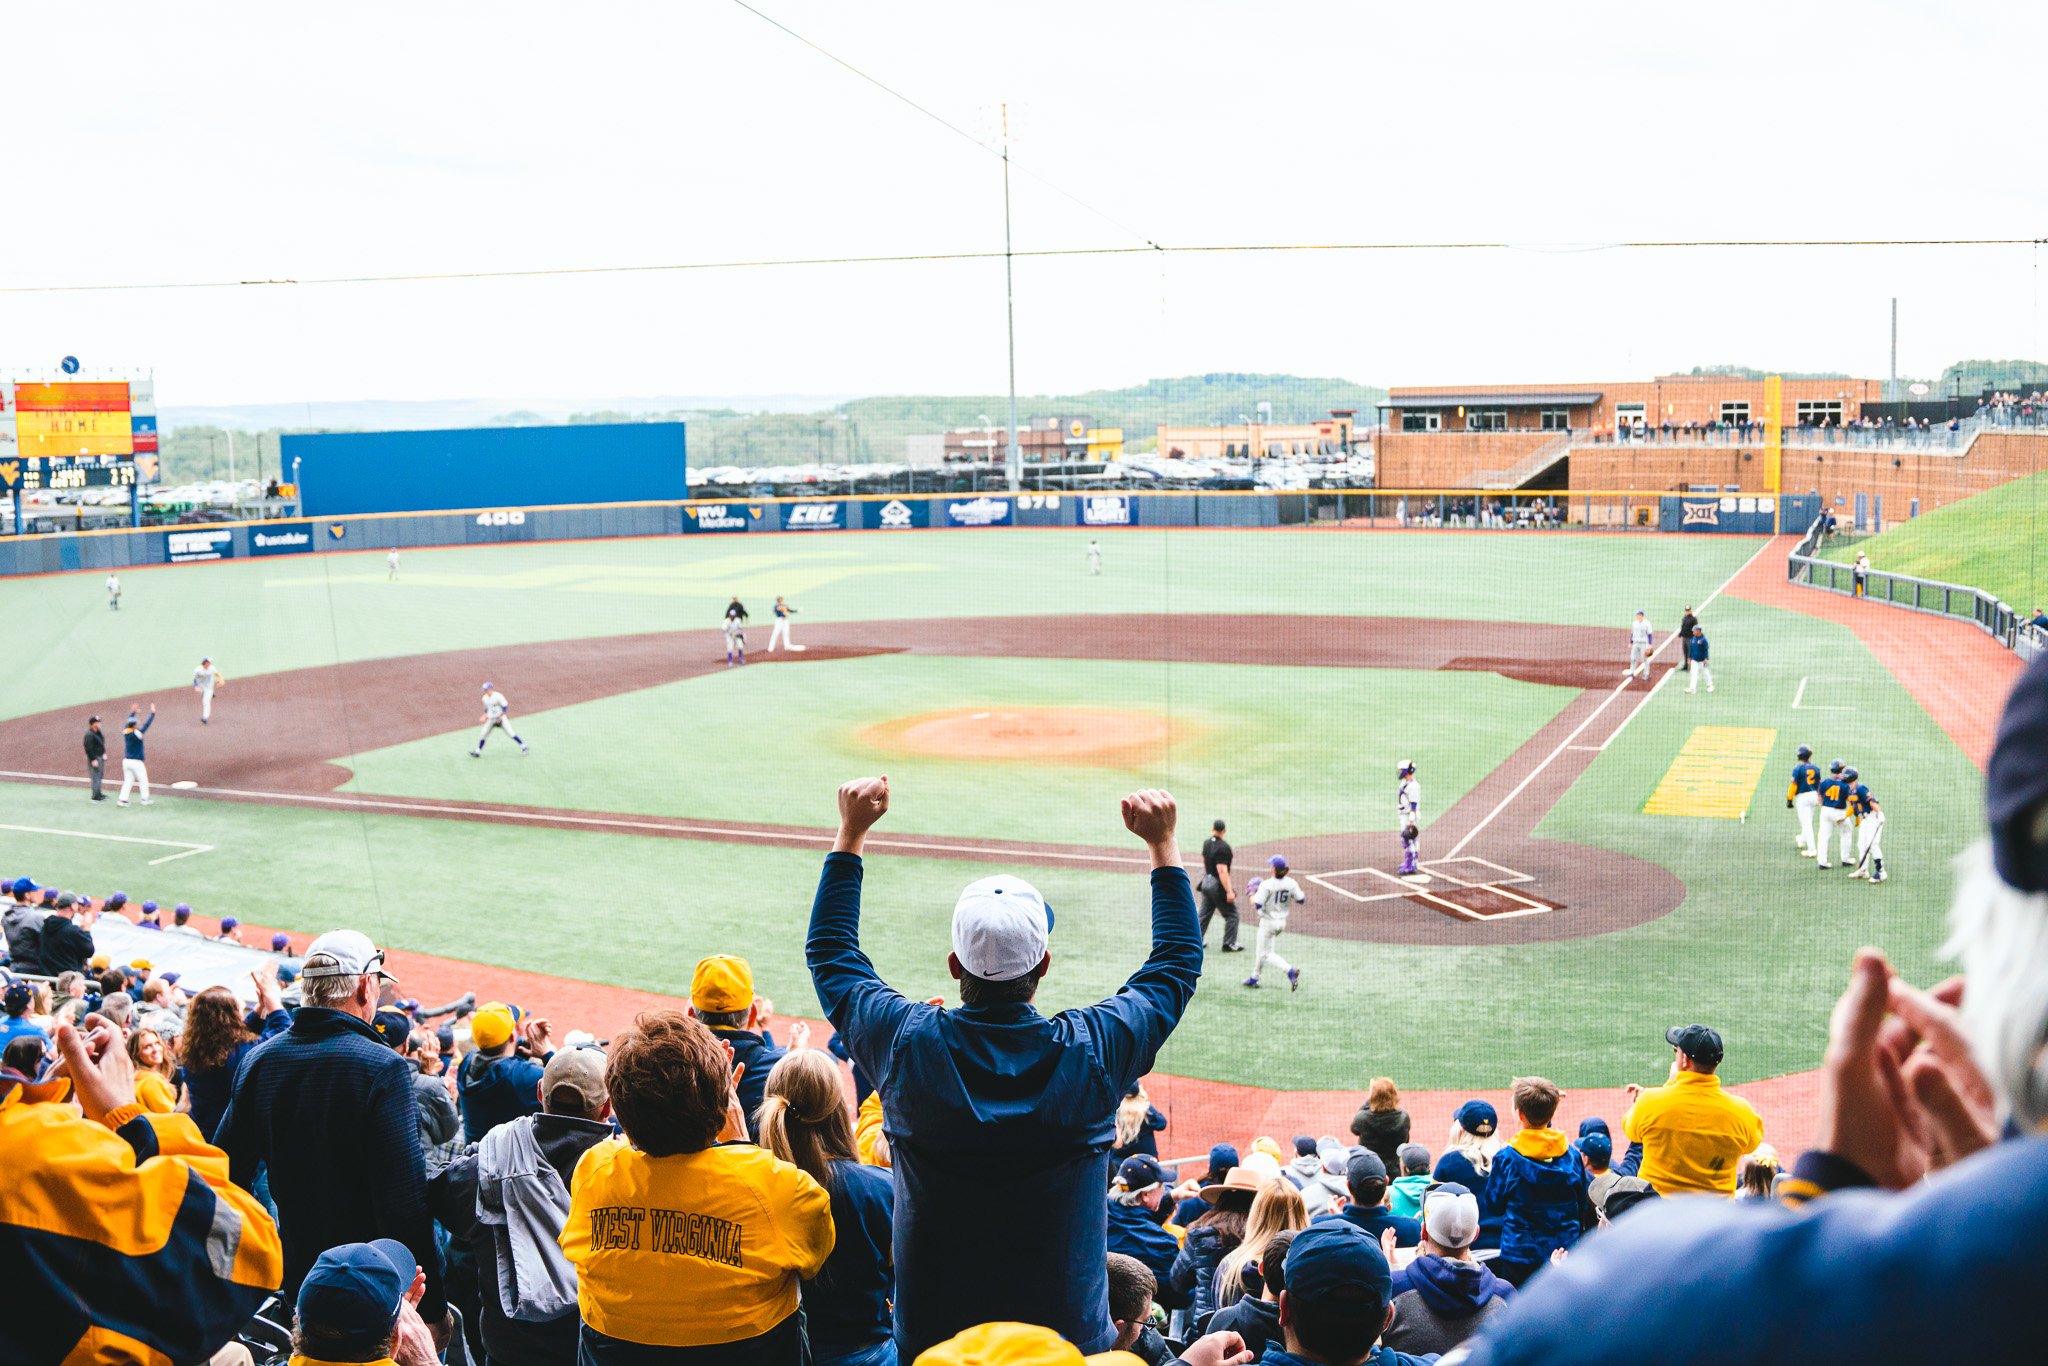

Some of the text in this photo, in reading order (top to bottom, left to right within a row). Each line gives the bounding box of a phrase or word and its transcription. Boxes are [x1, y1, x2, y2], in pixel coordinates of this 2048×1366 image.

[51, 419, 98, 433] HOME
[476, 511, 526, 527] 400
[1806, 769, 1816, 785] 2
[1825, 785, 1841, 801] 41
[590, 1206, 743, 1268] WEST VIRGINIA
